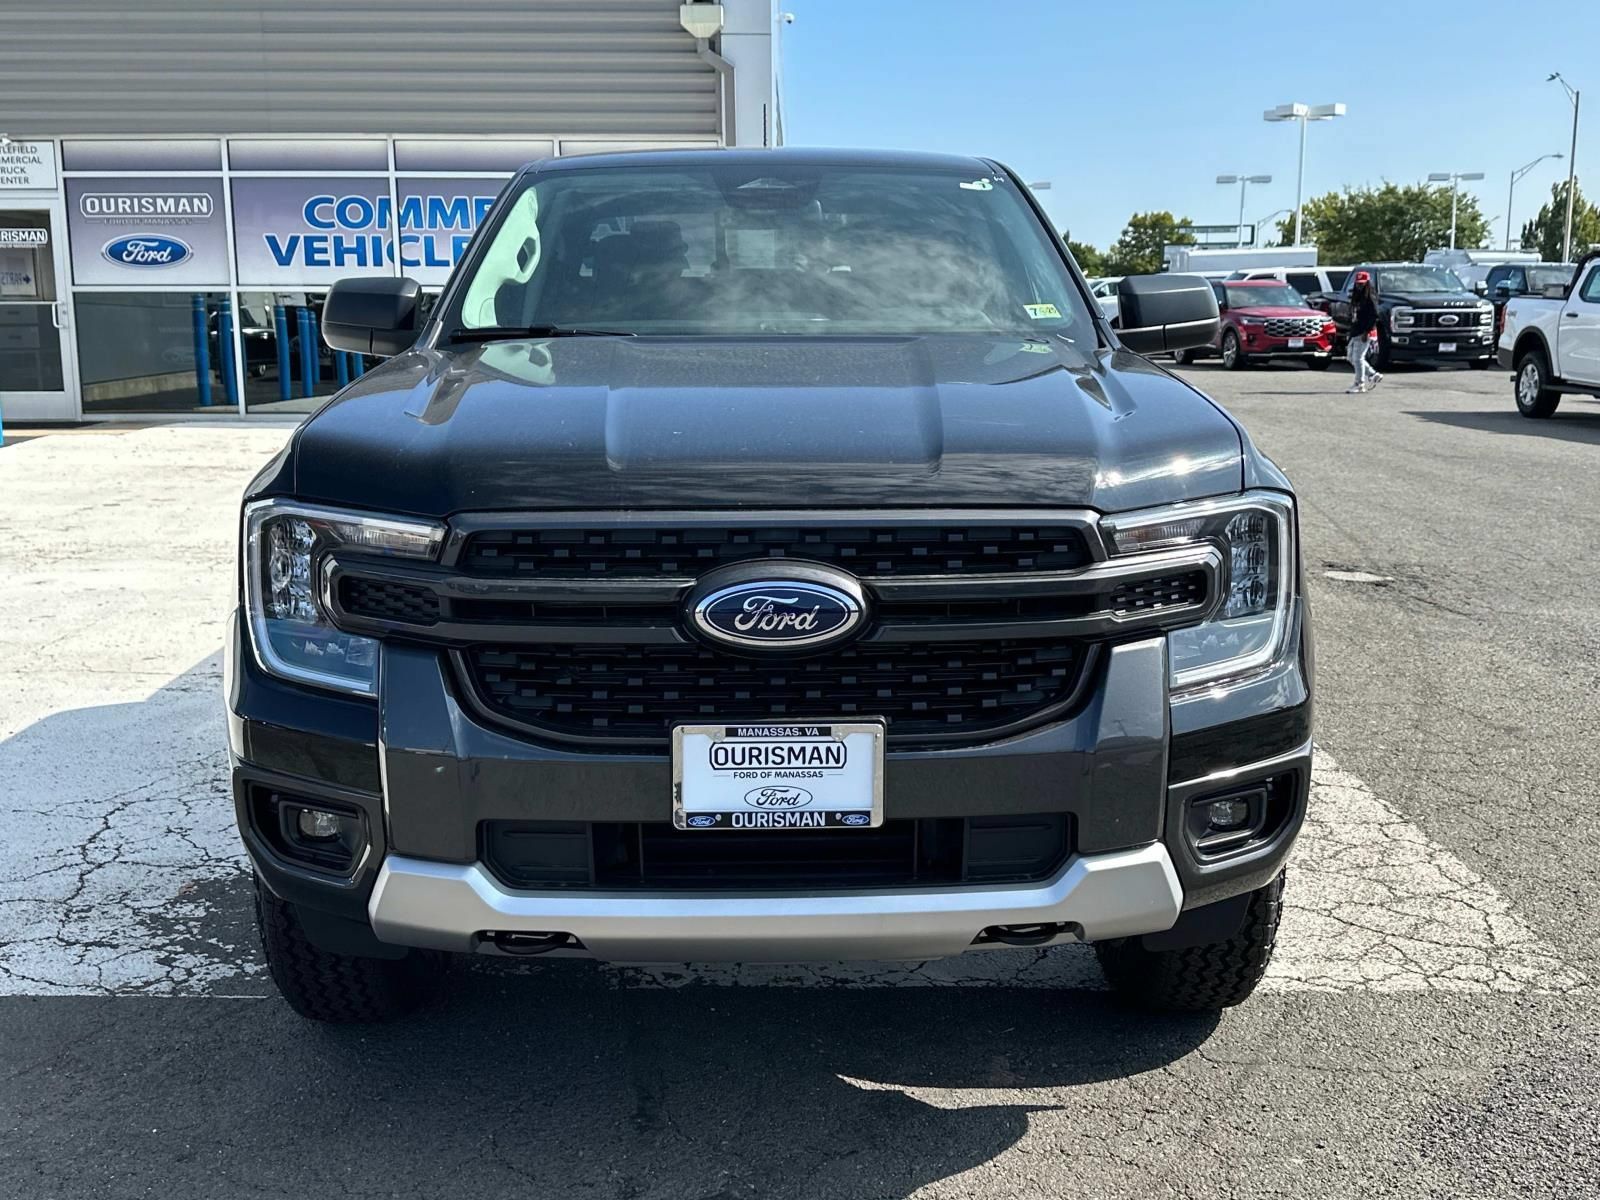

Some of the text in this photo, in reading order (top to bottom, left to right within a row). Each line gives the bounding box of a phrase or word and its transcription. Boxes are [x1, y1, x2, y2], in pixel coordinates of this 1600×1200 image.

[0, 155, 43, 165] MERCIAL
[0, 166, 26, 175] RUCK
[0, 176, 30, 185] ENTER
[86, 197, 208, 213] OURISMAN
[1, 231, 45, 242] RISMAN
[122, 240, 172, 262] Ford
[734, 595, 820, 631] Ford
[805, 728, 819, 736] VA
[713, 745, 842, 767] OURISMAN
[733, 771, 824, 779] FORD OF MANASSAS
[756, 787, 801, 807] Ford
[692, 812, 867, 827] Ford OURISMAN Ford
